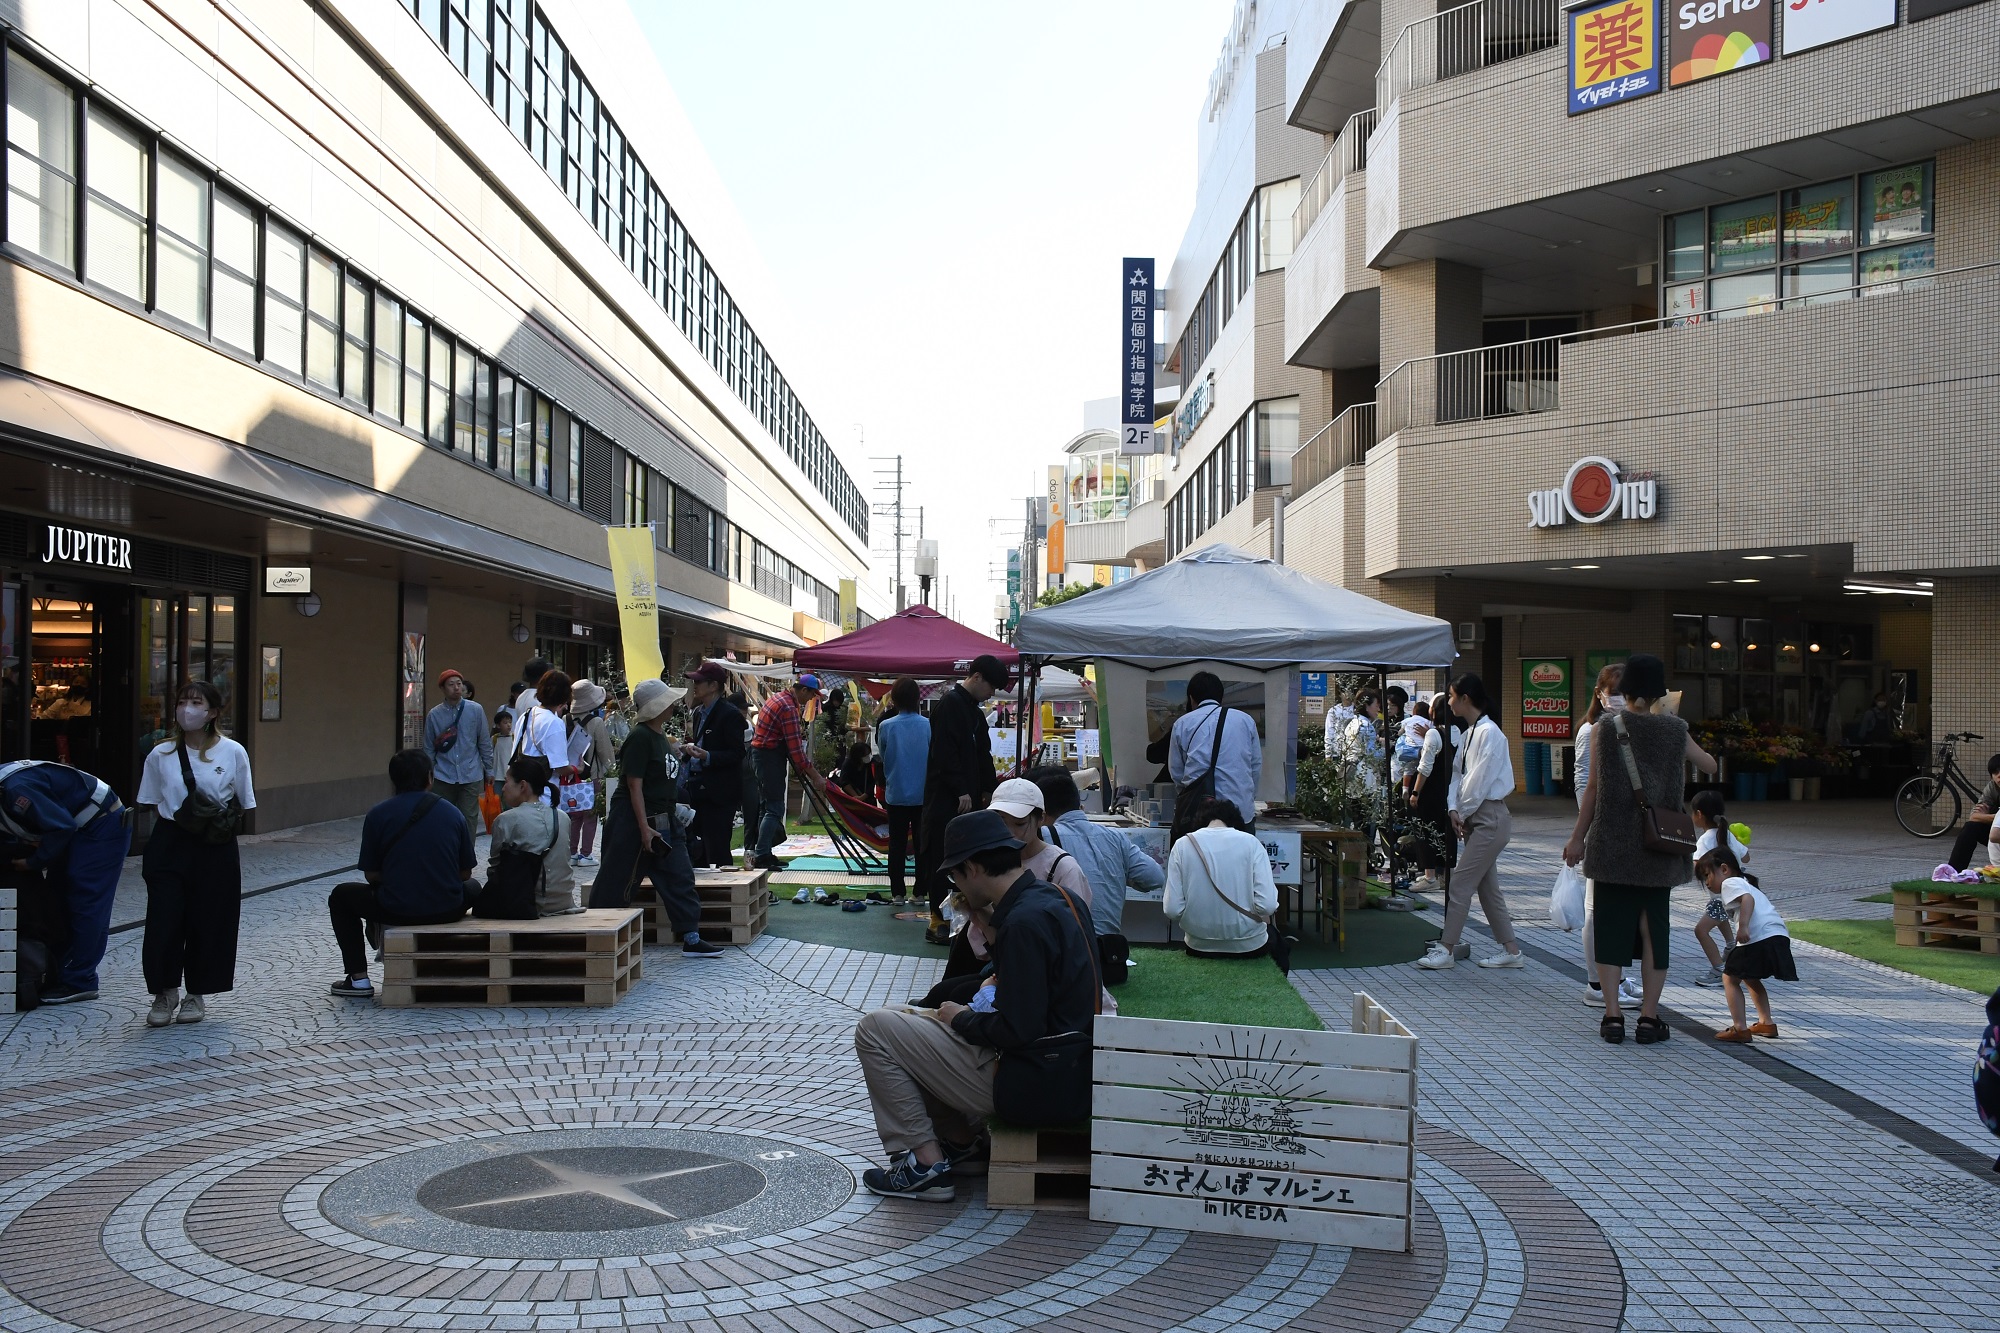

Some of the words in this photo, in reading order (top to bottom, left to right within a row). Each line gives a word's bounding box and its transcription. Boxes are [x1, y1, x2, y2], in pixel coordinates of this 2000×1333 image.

[1679, 0, 1762, 30] Seria
[1584, 2, 1643, 83] 薬
[1577, 75, 1650, 105] マツモトキヨシ
[1130, 289, 1147, 418] 関西個別指導学院
[1126, 427, 1150, 446] 2F
[42, 525, 132, 570] JUPITER
[1532, 670, 1561, 682] Saizeriya
[1523, 697, 1570, 712] サイゼリヤ
[1523, 722, 1554, 734] IKEDIA
[1555, 723, 1569, 734] 2F
[1270, 859, 1290, 871] ラマ
[1143, 1163, 1354, 1204] おさんぽマルシェ
[1204, 1200, 1217, 1214] in
[1223, 1204, 1288, 1223] IKEDA
